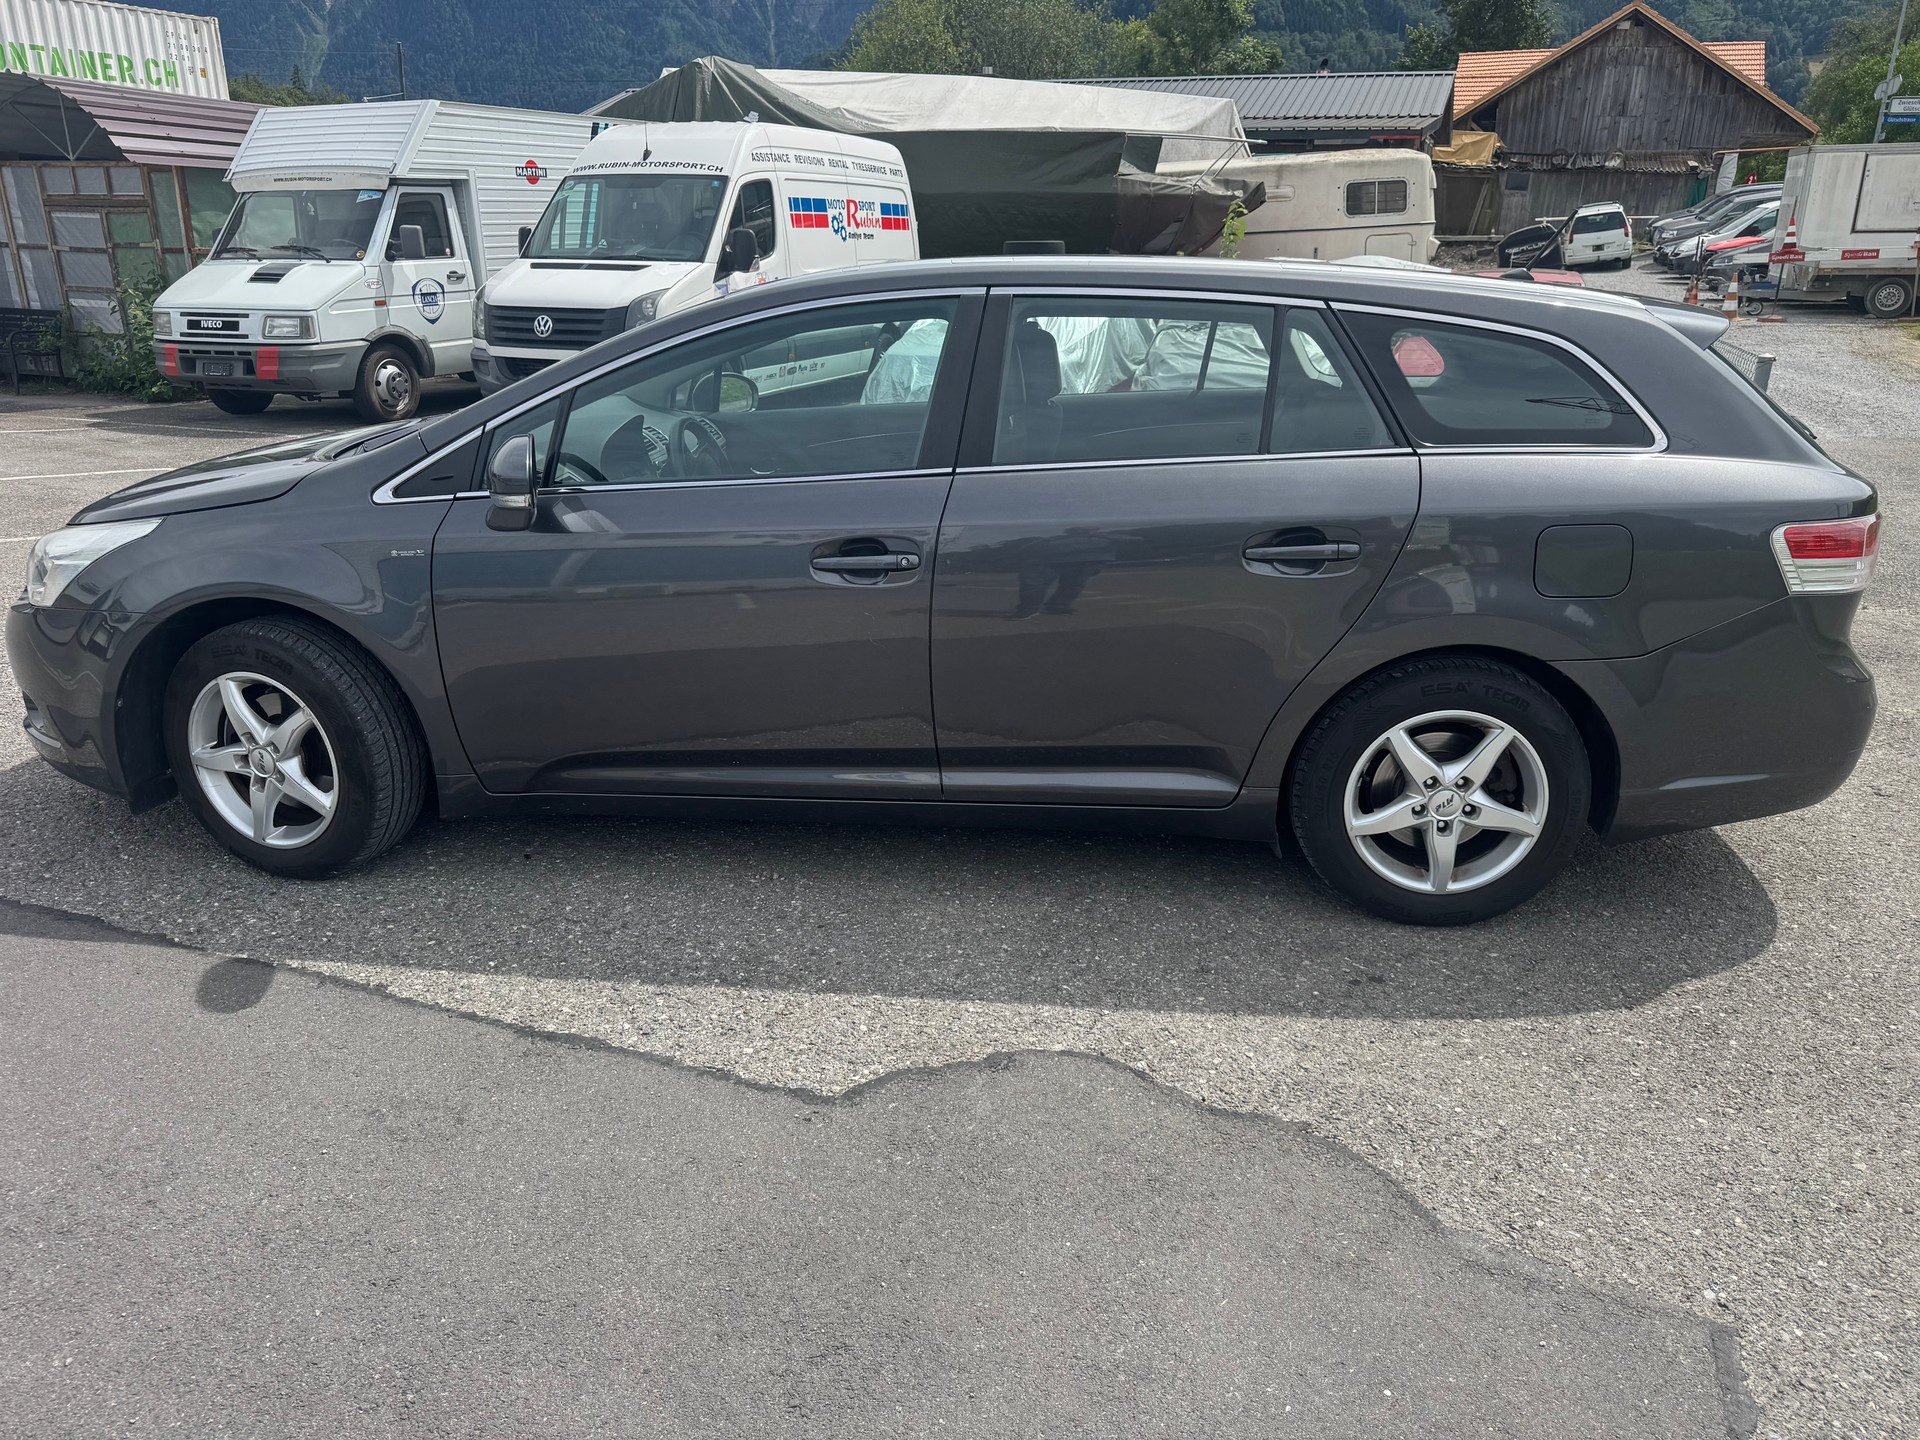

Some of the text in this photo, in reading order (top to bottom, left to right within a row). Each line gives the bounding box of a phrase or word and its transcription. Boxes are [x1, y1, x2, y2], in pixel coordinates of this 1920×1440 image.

[572, 161, 724, 174] WWW.RUBIN-MOTORSPORT.CH
[751, 152, 904, 178] ASSISTANCE REVISIONS RENTAL TYRESSERVICE PARTS
[516, 167, 547, 177] MARTINI
[827, 199, 876, 212] MOTO SPORT
[846, 199, 882, 230] Rubin
[863, 232, 875, 240] Team
[421, 295, 438, 303] LANCIA
[200, 320, 222, 328] IVECO
[1483, 685, 1531, 712] TECAR
